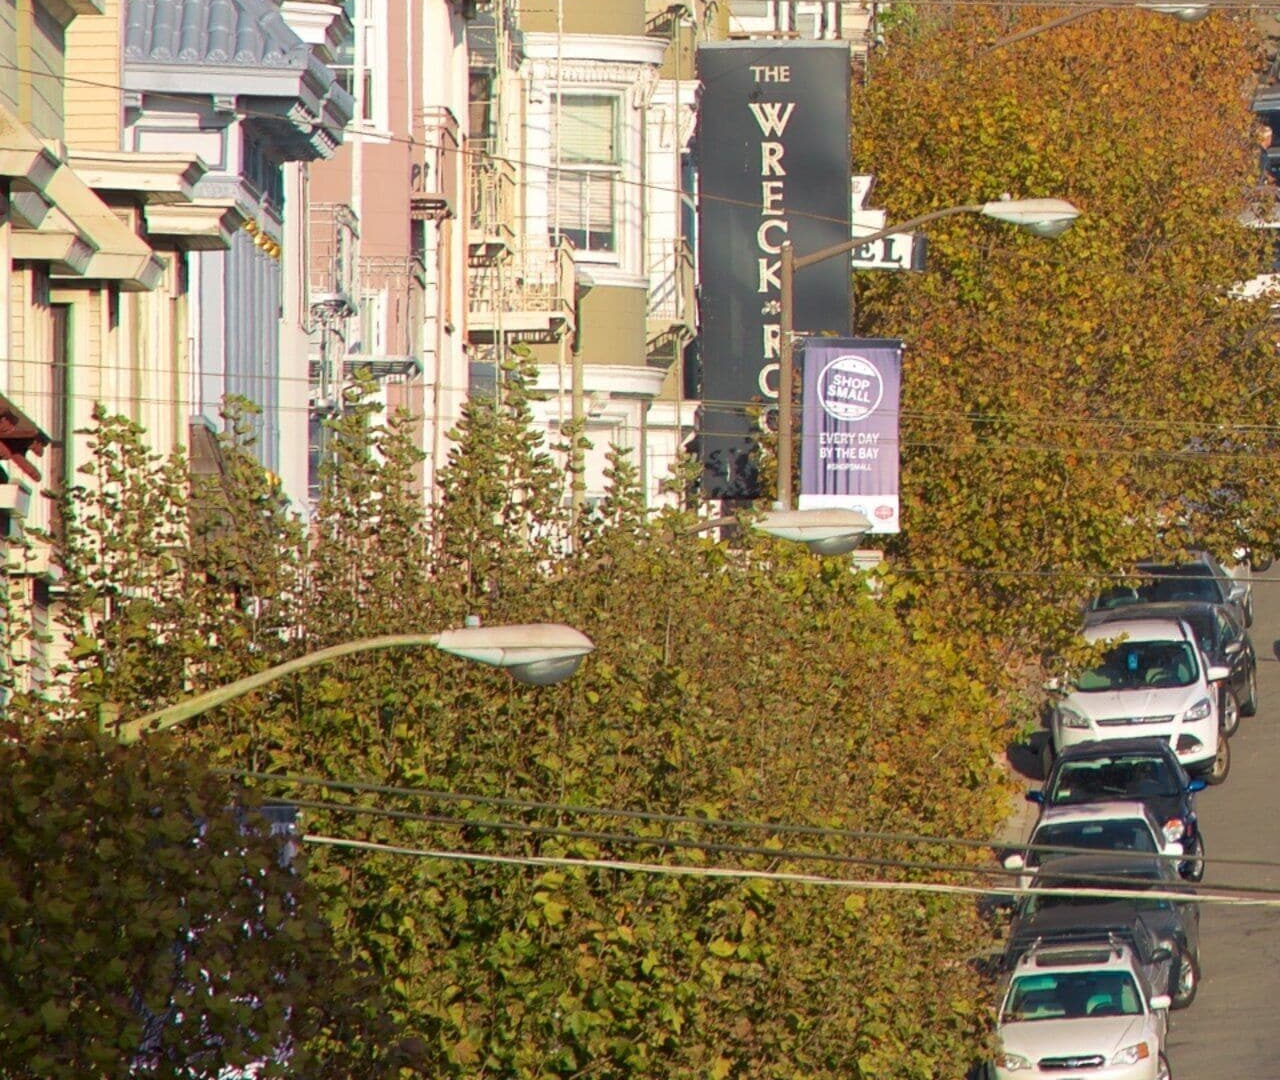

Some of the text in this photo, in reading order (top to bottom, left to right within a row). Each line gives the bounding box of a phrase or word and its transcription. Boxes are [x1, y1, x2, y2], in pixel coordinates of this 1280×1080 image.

[749, 66, 791, 82] THE
[748, 102, 795, 293] WRECK
[833, 375, 870, 390] SHOP
[827, 385, 871, 403] SMALL
[820, 432, 879, 444] EVERY DAY
[820, 447, 879, 459] BY THE BAY
